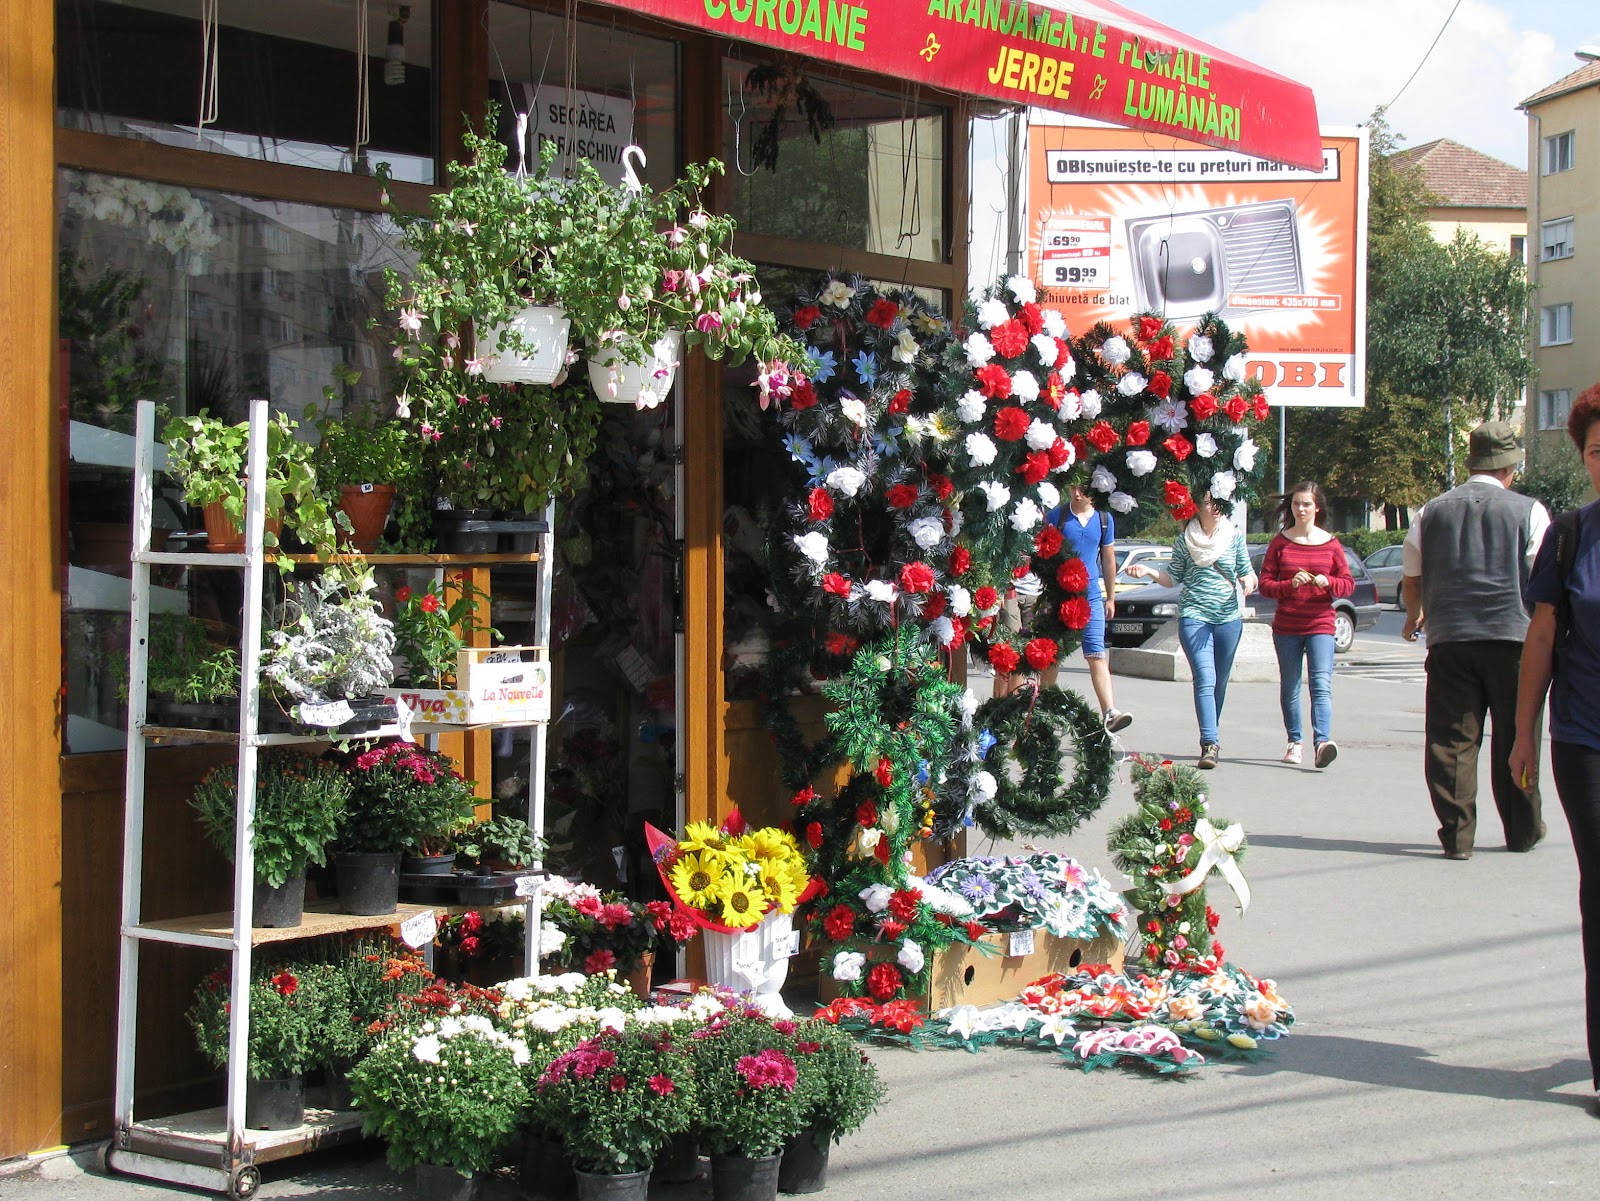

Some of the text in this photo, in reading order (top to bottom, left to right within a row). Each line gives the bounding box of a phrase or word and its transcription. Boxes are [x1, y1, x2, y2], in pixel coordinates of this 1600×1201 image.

[988, 45, 1241, 142] JERBE LUMÂNĂRI
[549, 103, 616, 134] SECĂREA
[538, 132, 625, 165] PRASCHIV
[1056, 159, 1173, 176] OBIșnuiește-te
[1177, 161, 1196, 173] cu
[1200, 159, 1251, 175] prețuri
[1043, 293, 1130, 306] hiuvetă de blat
[1320, 299, 1335, 307] mm
[1245, 360, 1346, 388] OBI
[401, 692, 446, 713] Uva
[483, 686, 544, 701] La Nouvelle
